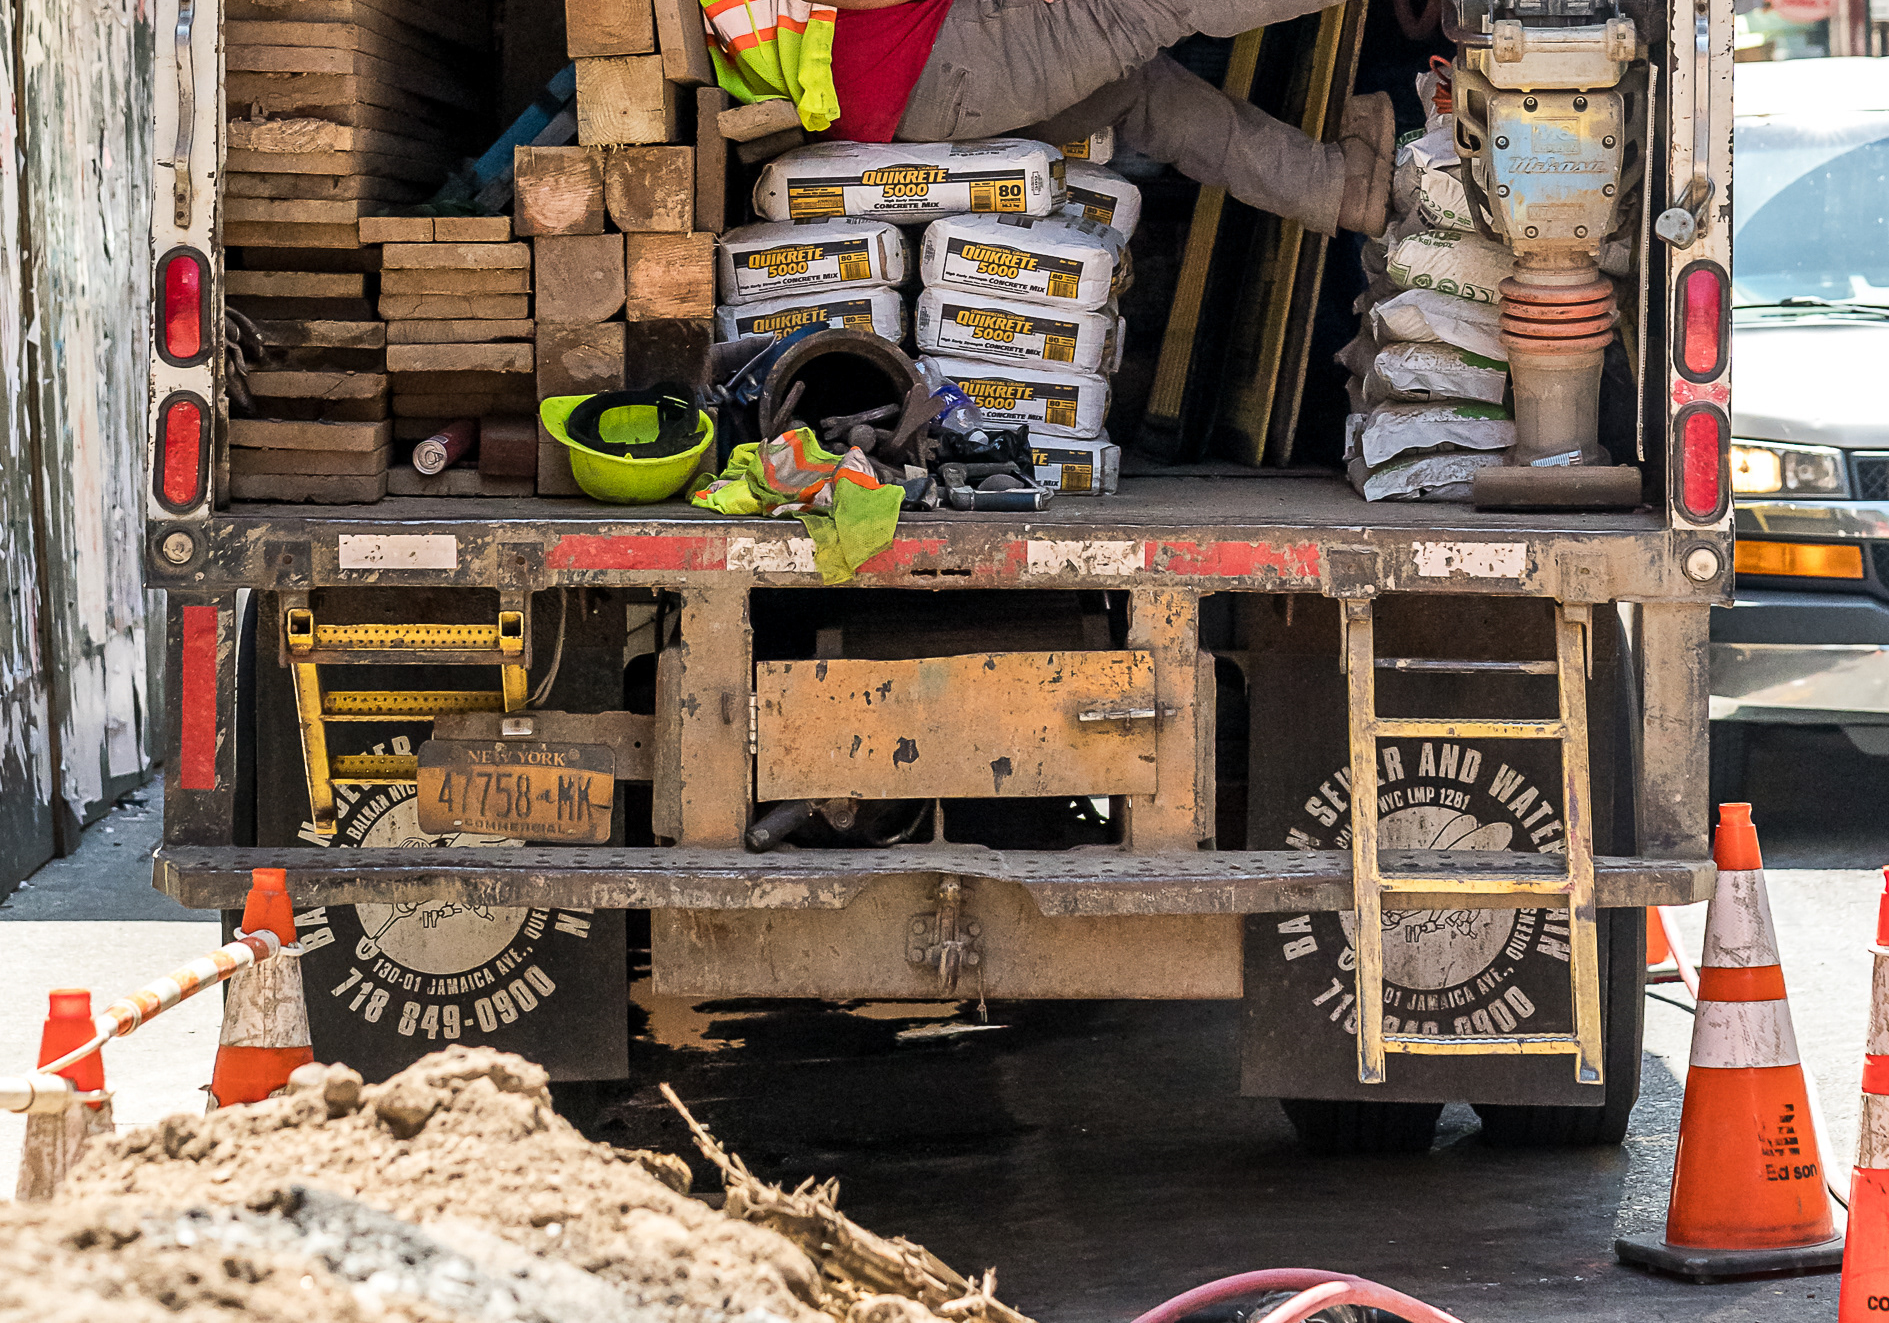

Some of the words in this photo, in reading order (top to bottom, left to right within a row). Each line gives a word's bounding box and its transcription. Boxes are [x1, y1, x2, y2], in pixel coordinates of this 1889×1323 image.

[861, 169, 948, 185] QUIKRETE
[883, 184, 928, 197] 5000
[998, 185, 1021, 197] 80
[748, 247, 824, 268] QUIKRETE
[961, 244, 1039, 271] QUIKRETE
[768, 262, 809, 278] 5000
[977, 262, 1019, 279] 5000
[783, 274, 821, 284] CONCRETE
[988, 277, 1029, 290] CONCRETE
[1029, 284, 1046, 293] MIX
[753, 308, 828, 334] QUIKRETE
[956, 310, 1034, 335] QUIKRETE
[972, 327, 1015, 343] 5000
[984, 342, 1024, 354] CONCRETE
[1025, 348, 1041, 357] MIX
[957, 381, 1034, 400] QUIKRETE
[975, 397, 1016, 410] 5000
[986, 411, 1026, 420] CONCRETE
[1027, 413, 1043, 421] MIX
[467, 750, 511, 766] NEW
[517, 751, 566, 767] YORK
[1304, 746, 1405, 828] SER
[1418, 742, 1483, 784] AND
[1378, 790, 1405, 814] NYC
[1407, 786, 1435, 805] LMP
[1439, 787, 1471, 811] 1281
[346, 794, 391, 841] BALKAN
[463, 818, 567, 835] COMMERCIAL
[372, 958, 422, 993] 130-01
[427, 968, 496, 996] JAMAICA
[331, 966, 391, 1023] 718
[397, 964, 556, 1040] 849-0900
[1406, 985, 1476, 1012] JAMAICA
